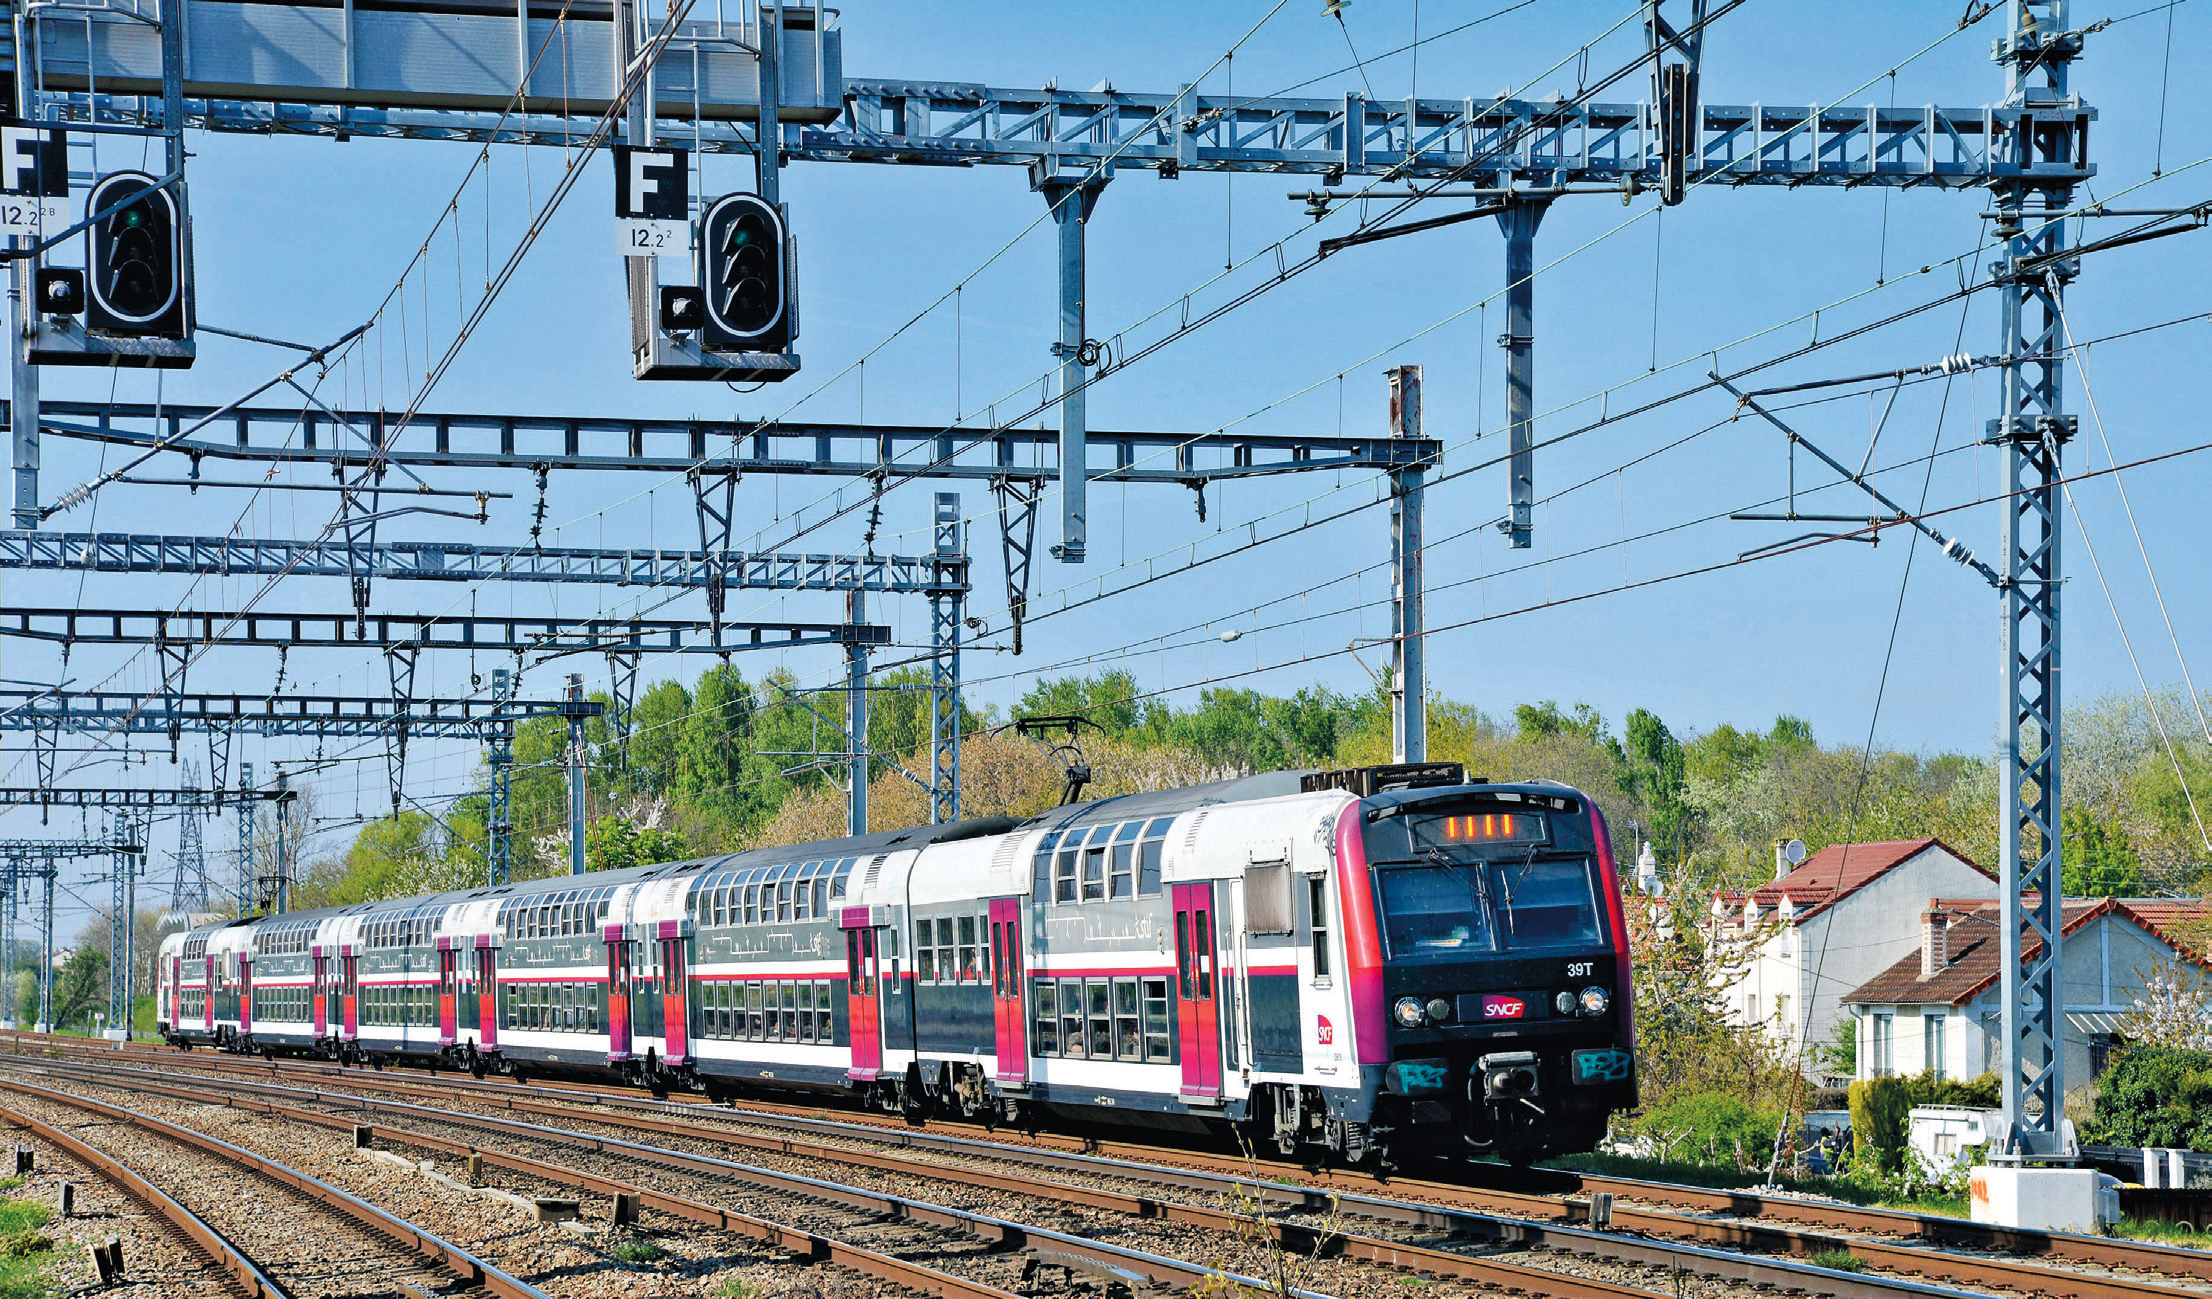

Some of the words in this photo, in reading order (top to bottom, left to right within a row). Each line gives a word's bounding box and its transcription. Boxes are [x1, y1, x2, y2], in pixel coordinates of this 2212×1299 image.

[1, 127, 50, 190] F
[630, 151, 674, 213] F
[1567, 962, 1594, 977] 39T
[1484, 1003, 1523, 1016] SNCF
